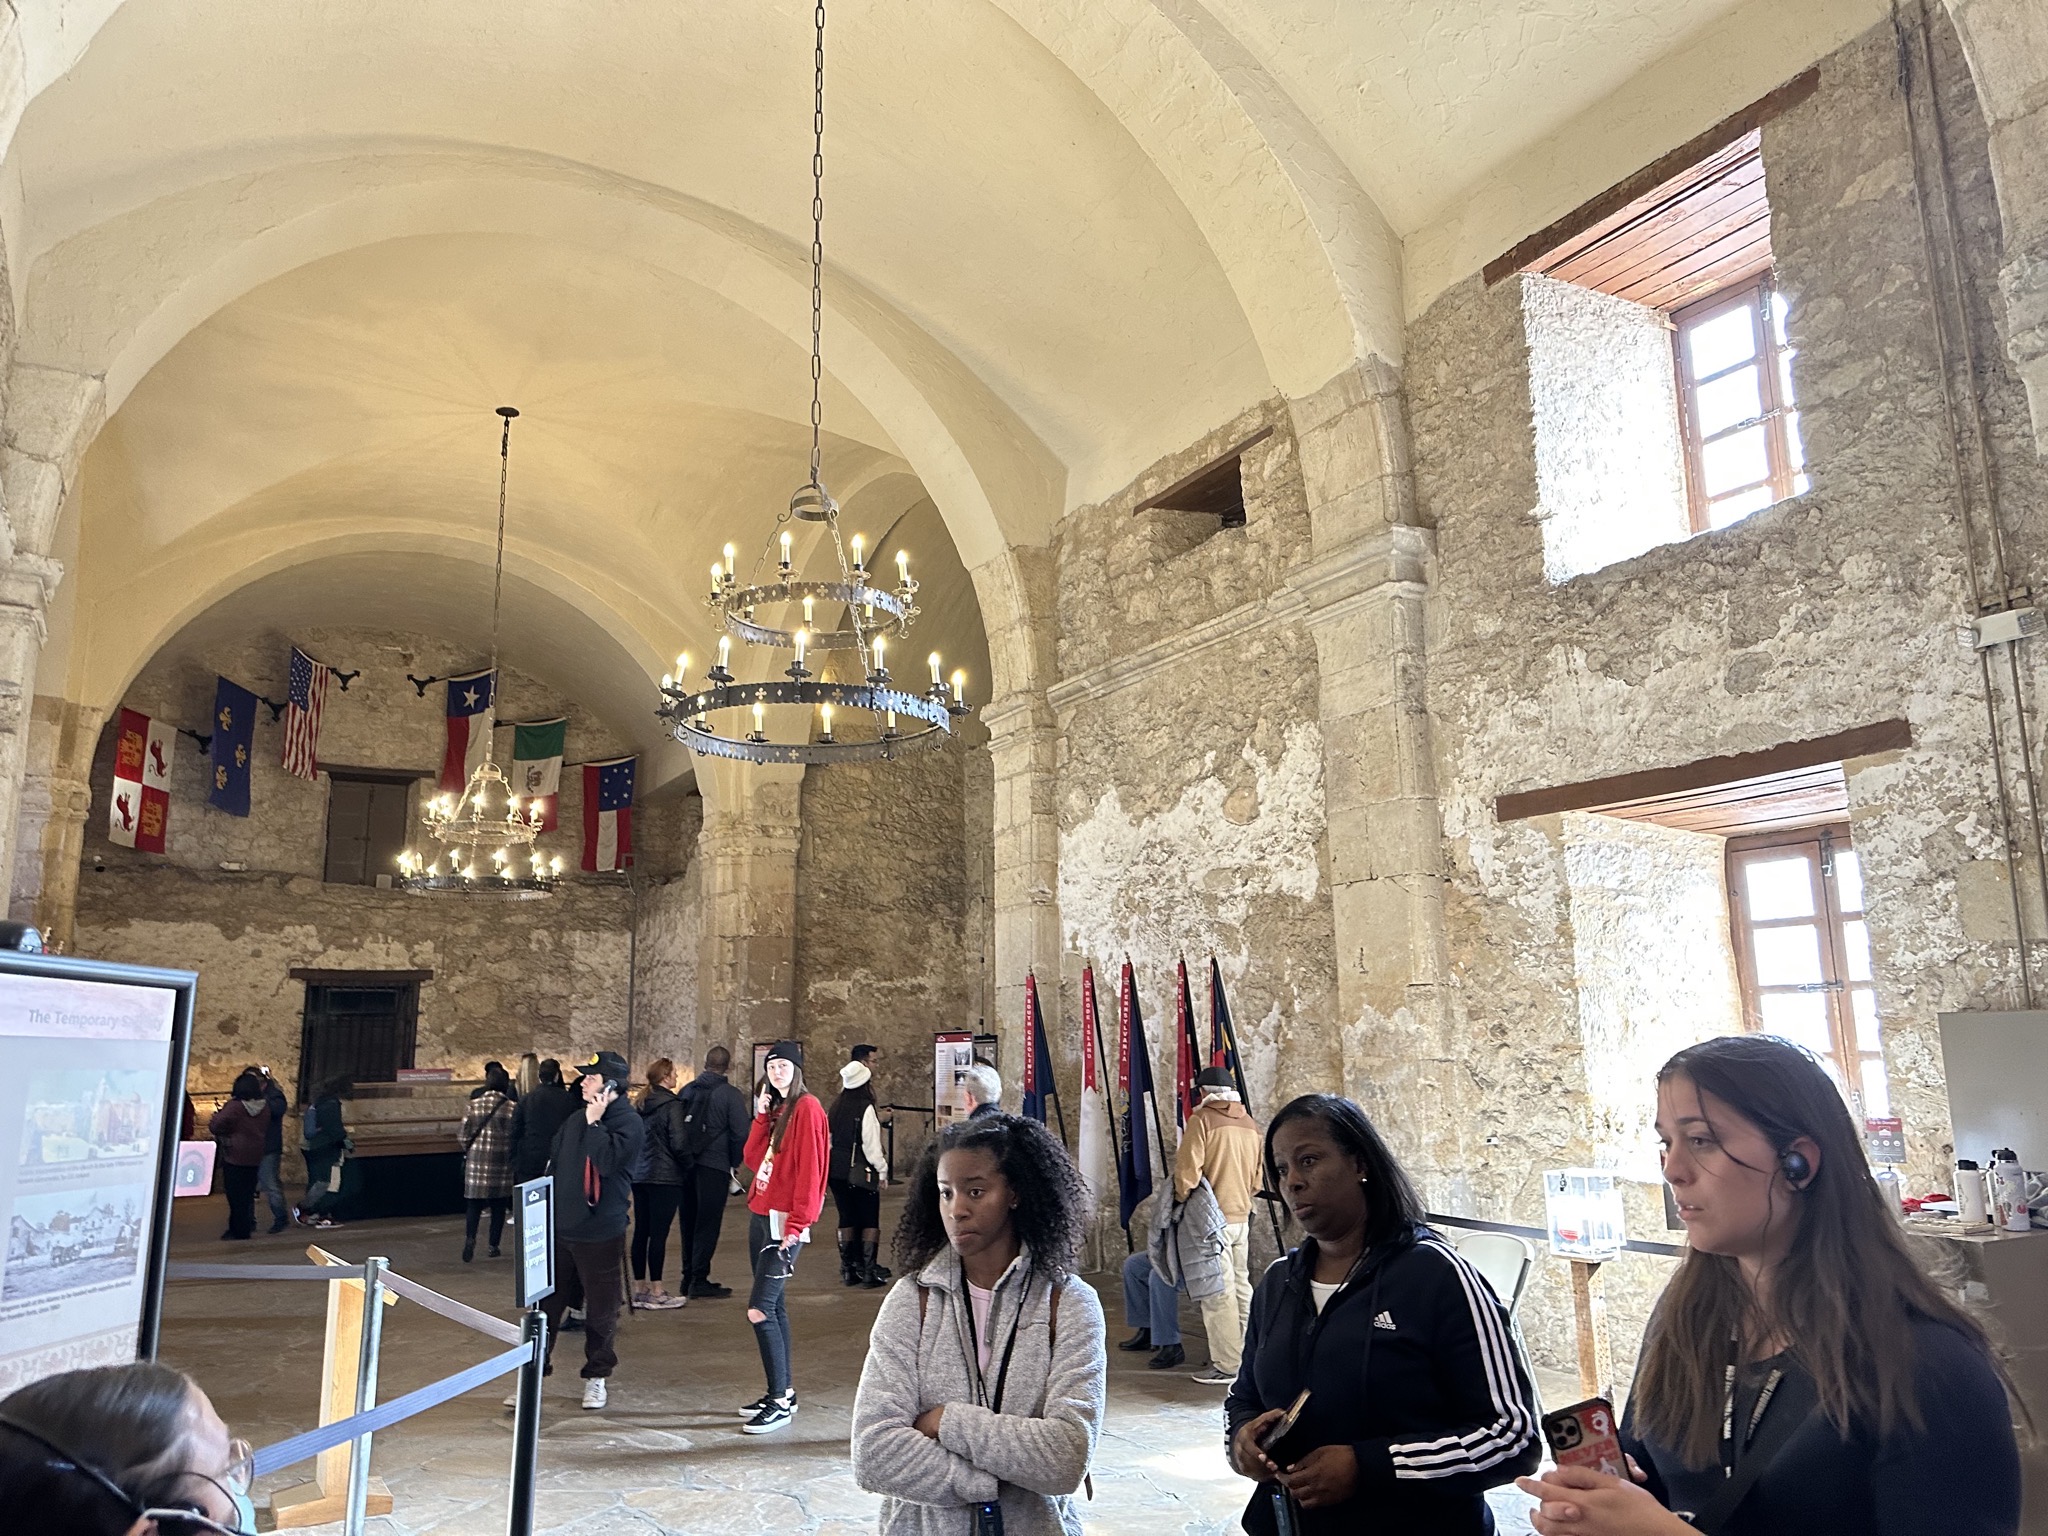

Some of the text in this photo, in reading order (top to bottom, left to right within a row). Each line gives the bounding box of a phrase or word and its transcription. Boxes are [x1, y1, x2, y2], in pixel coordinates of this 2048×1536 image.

[29, 1009, 50, 1024] The
[55, 1011, 119, 1030] Temporary
[186, 1169, 194, 1182] 8
[1373, 1320, 1396, 1330] adidas
